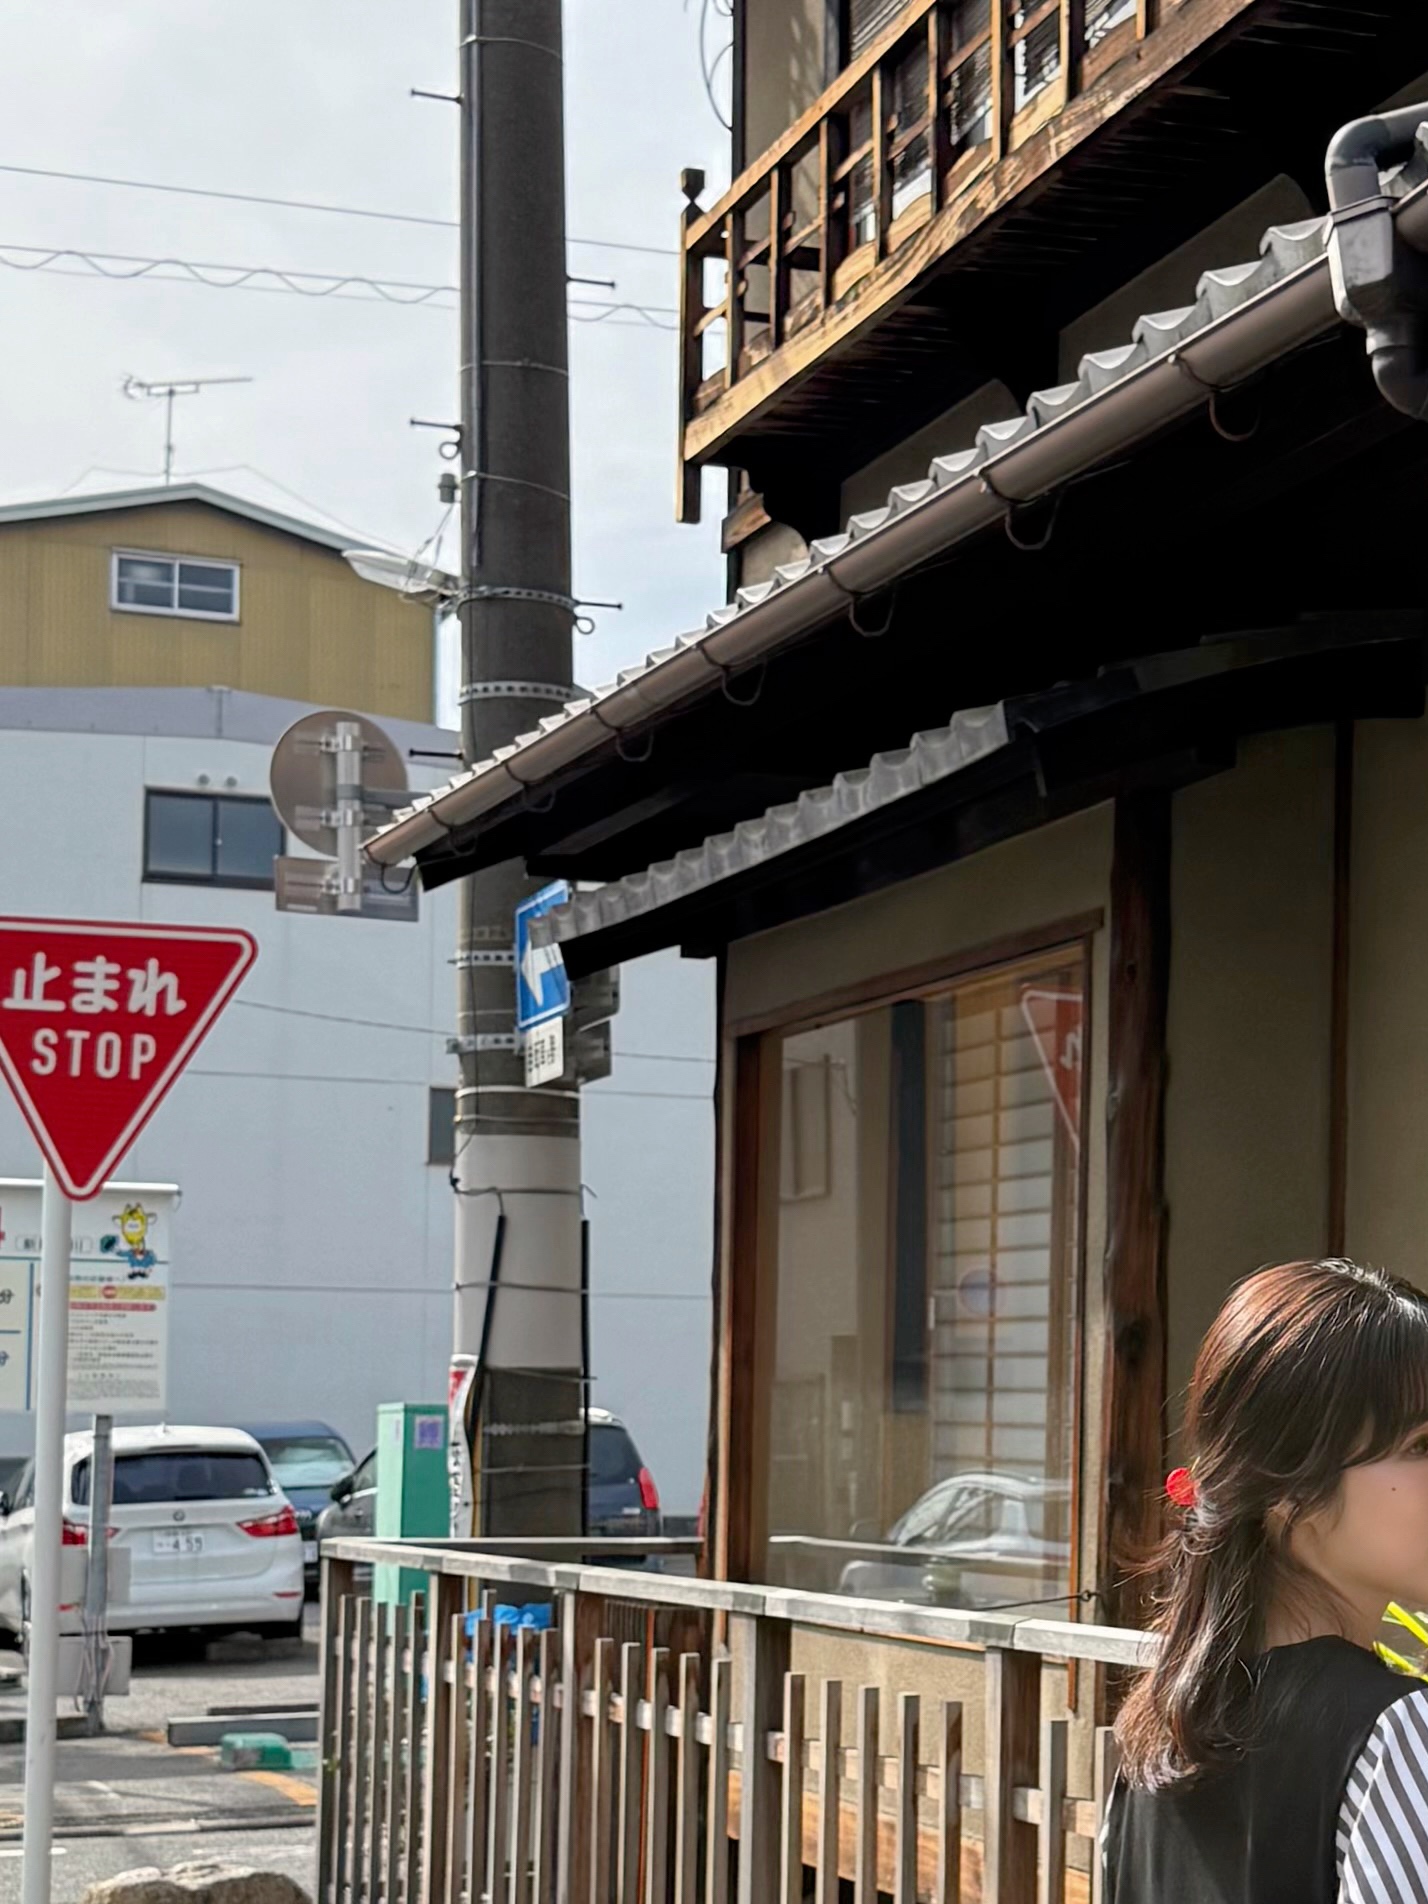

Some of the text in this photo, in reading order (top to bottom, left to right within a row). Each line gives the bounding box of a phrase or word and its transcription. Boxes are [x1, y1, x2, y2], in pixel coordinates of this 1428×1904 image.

[2, 951, 187, 1017] 止まれ
[31, 1028, 157, 1080] STOP
